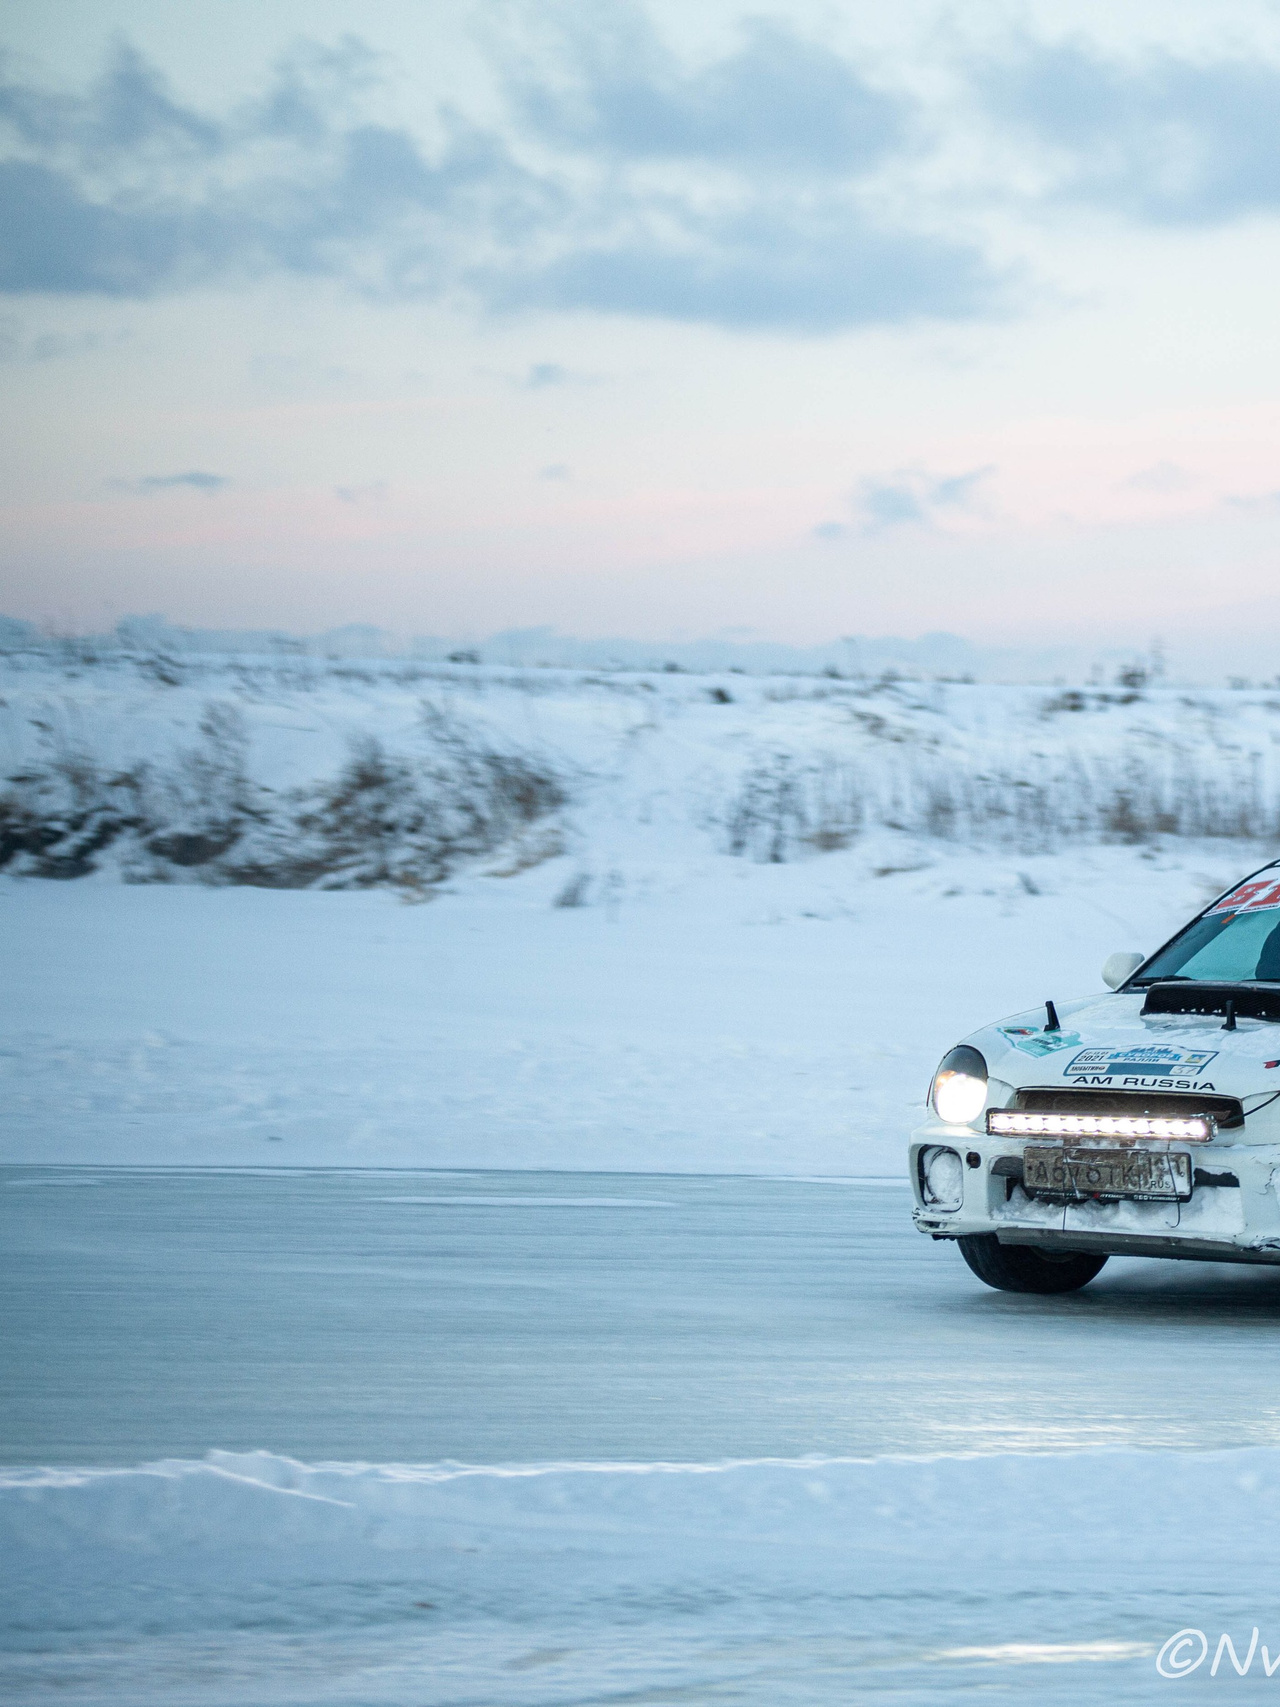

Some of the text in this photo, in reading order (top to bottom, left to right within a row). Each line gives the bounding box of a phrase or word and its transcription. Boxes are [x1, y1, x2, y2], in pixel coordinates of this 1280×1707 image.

[1072, 1076, 1216, 1091] AM RUSSIA
[1150, 1180, 1171, 1190] RUS
